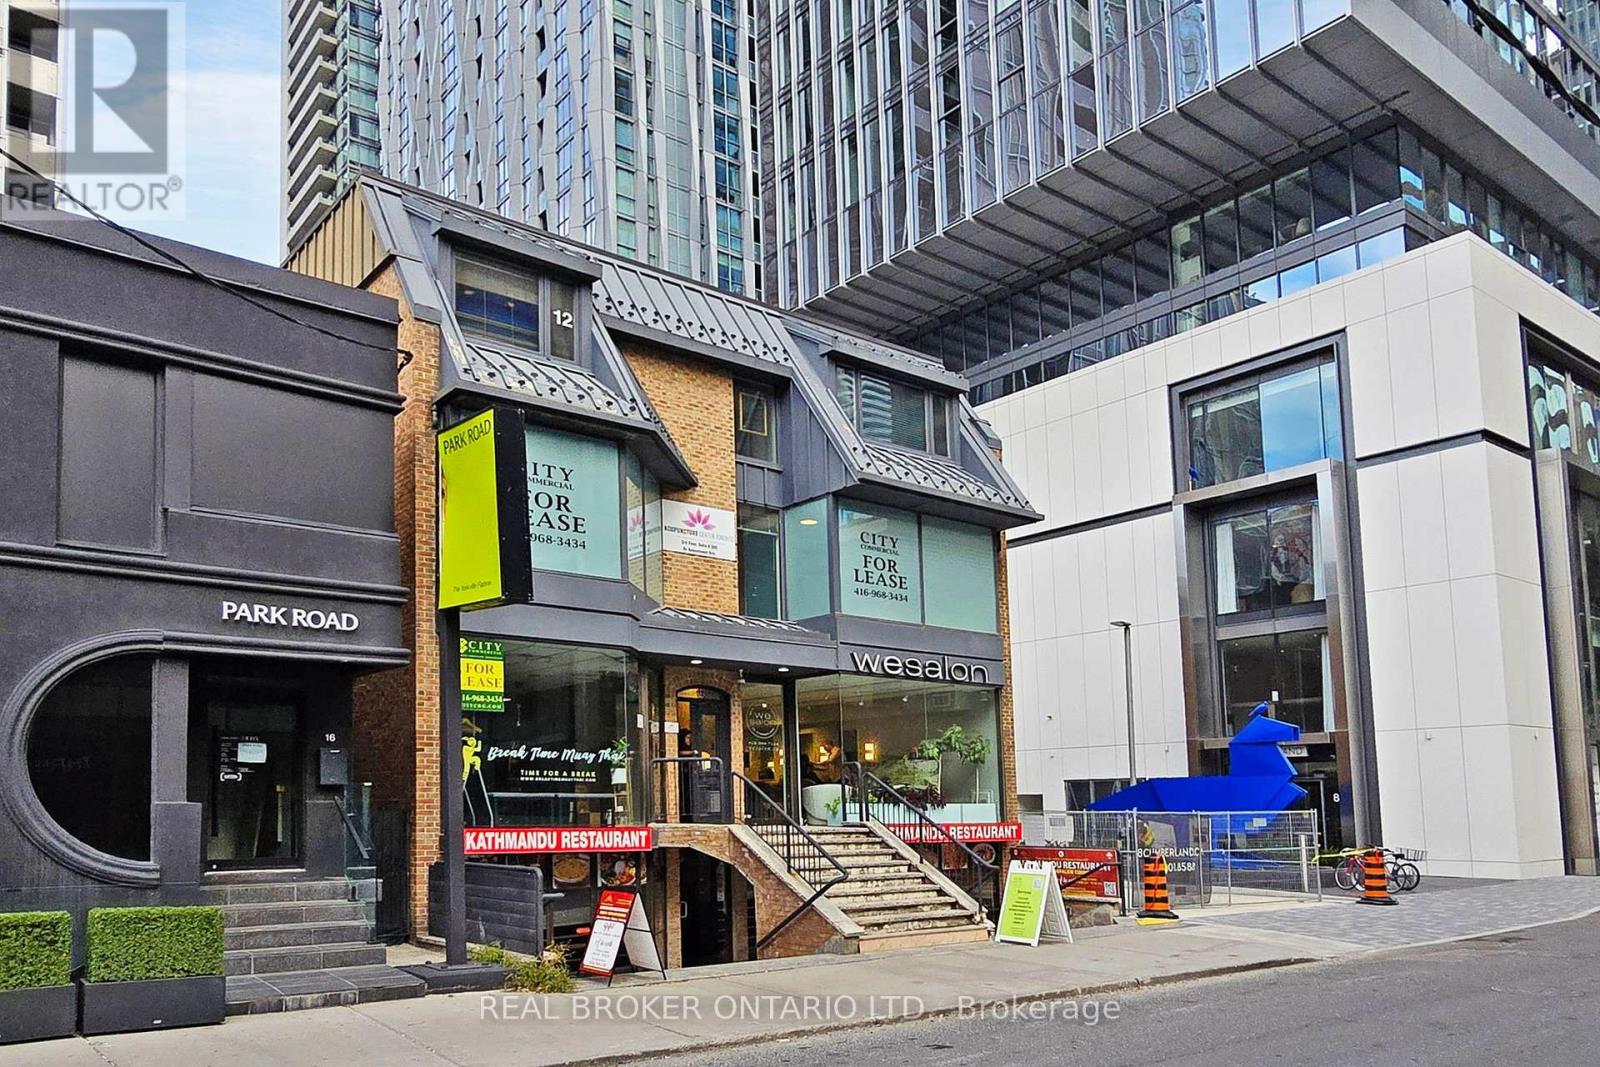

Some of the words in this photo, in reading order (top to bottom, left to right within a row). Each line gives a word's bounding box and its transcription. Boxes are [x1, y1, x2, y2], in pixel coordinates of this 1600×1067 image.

[552, 309, 574, 329] 12
[443, 432, 468, 455] PARK
[468, 419, 492, 442] ROAD
[532, 462, 574, 482] ITY
[528, 476, 575, 491] MMERCIAL
[528, 489, 573, 513] OR
[529, 532, 587, 549] 968-3434
[860, 531, 899, 549] CITY
[863, 554, 899, 574] FOR
[854, 568, 908, 590] LEASE
[854, 587, 908, 602] 416-968-3434
[221, 601, 288, 626] PARK
[292, 608, 359, 632] ROAD
[468, 640, 502, 651] CITY
[465, 662, 494, 674] FOR
[851, 652, 990, 684] wesalon
[466, 676, 502, 688] EASE
[325, 733, 336, 742] 16
[487, 745, 528, 761] Break
[530, 747, 559, 761] Time
[561, 748, 596, 764] Muay
[520, 769, 540, 777] TIME
[1332, 793, 1341, 803] 8
[464, 831, 557, 851] KATHMANDU
[561, 830, 648, 849] RESTAURANT
[949, 825, 1018, 840] RESTAURANT
